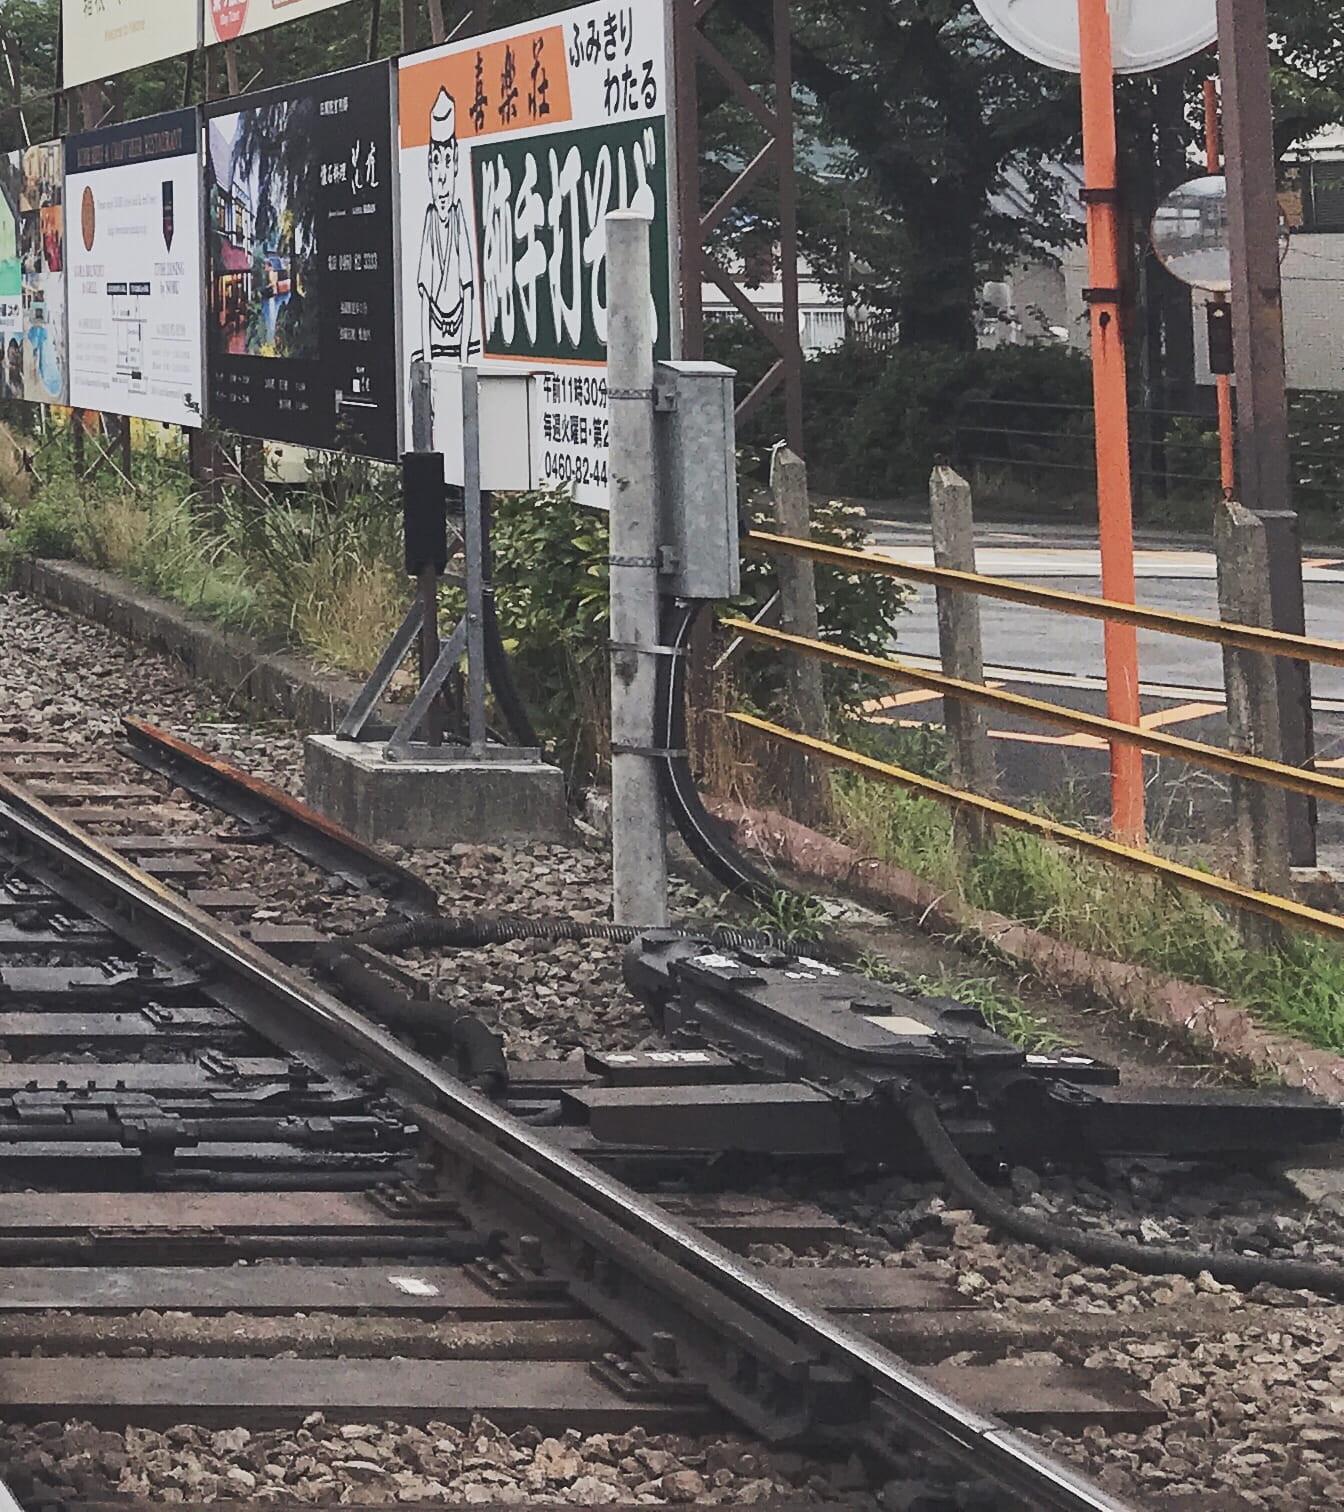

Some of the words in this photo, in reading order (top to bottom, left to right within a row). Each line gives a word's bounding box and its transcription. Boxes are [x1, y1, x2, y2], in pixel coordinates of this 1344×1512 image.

[568, 6, 633, 68] ふみきり
[604, 59, 657, 118] わたる
[543, 374, 608, 409] 午前11時30分
[543, 412, 609, 449] 毎週火曜日・第2
